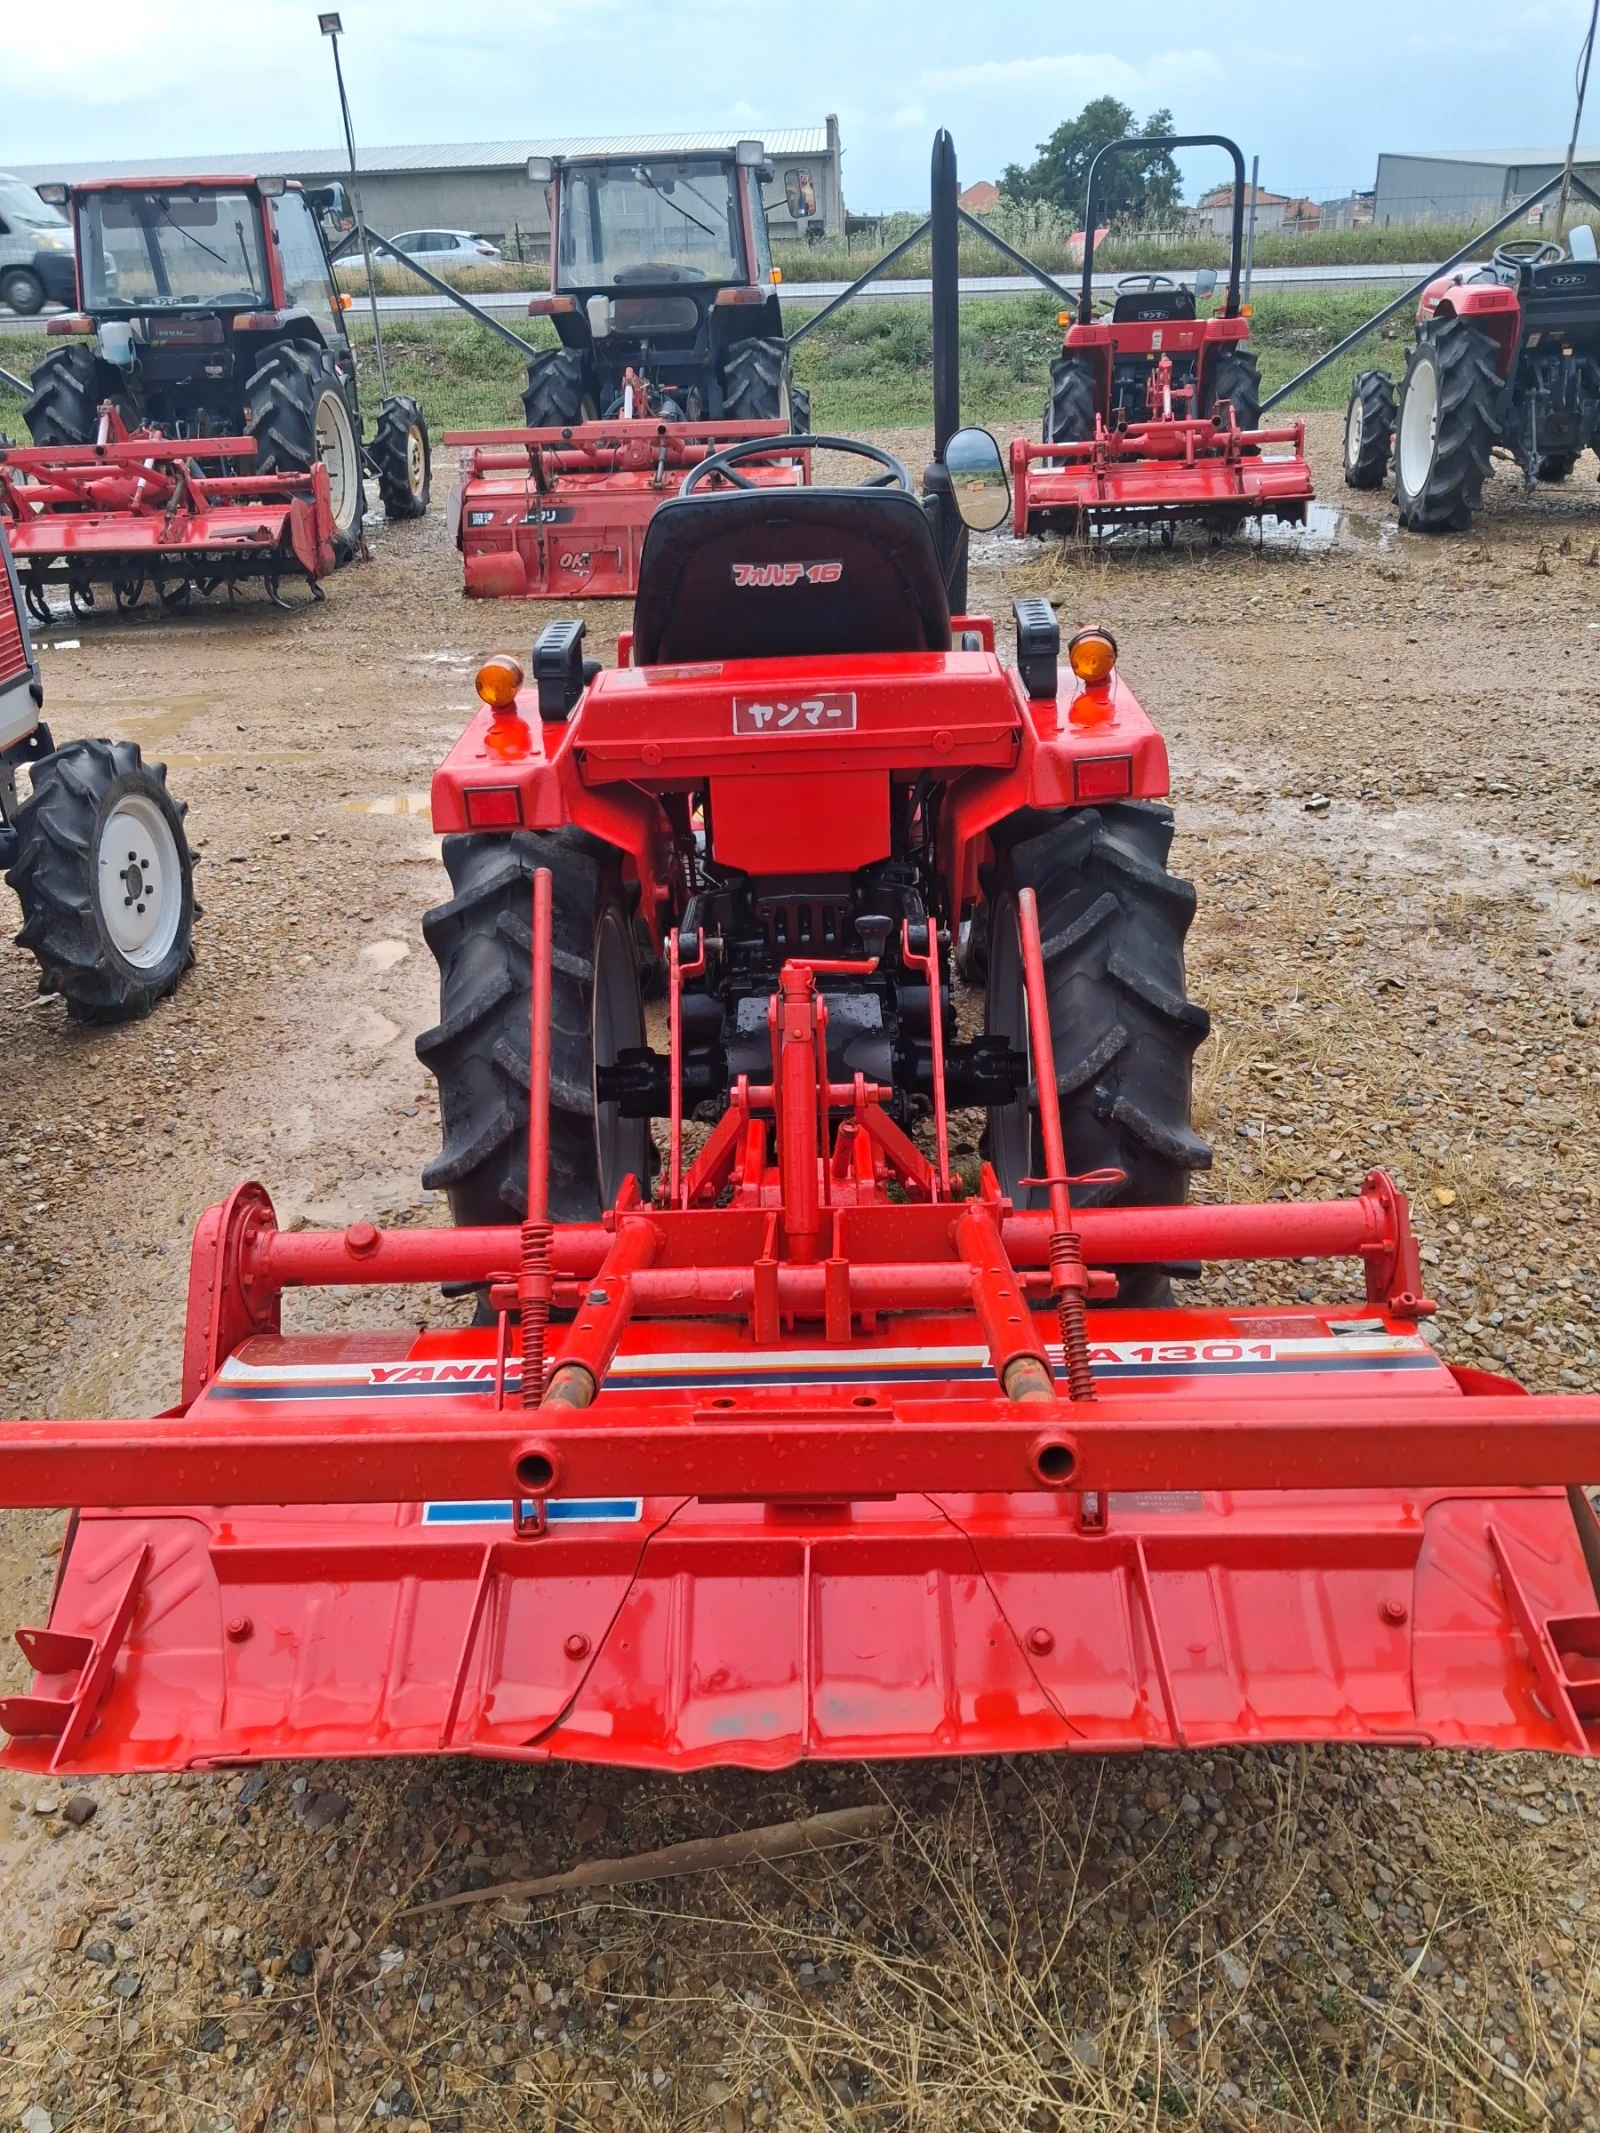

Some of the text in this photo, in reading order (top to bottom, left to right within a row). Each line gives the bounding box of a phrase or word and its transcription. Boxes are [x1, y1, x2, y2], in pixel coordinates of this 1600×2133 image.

[733, 563, 842, 586] フォルテ 16
[748, 701, 842, 728] ヤンマー
[371, 1363, 549, 1383] YANM
